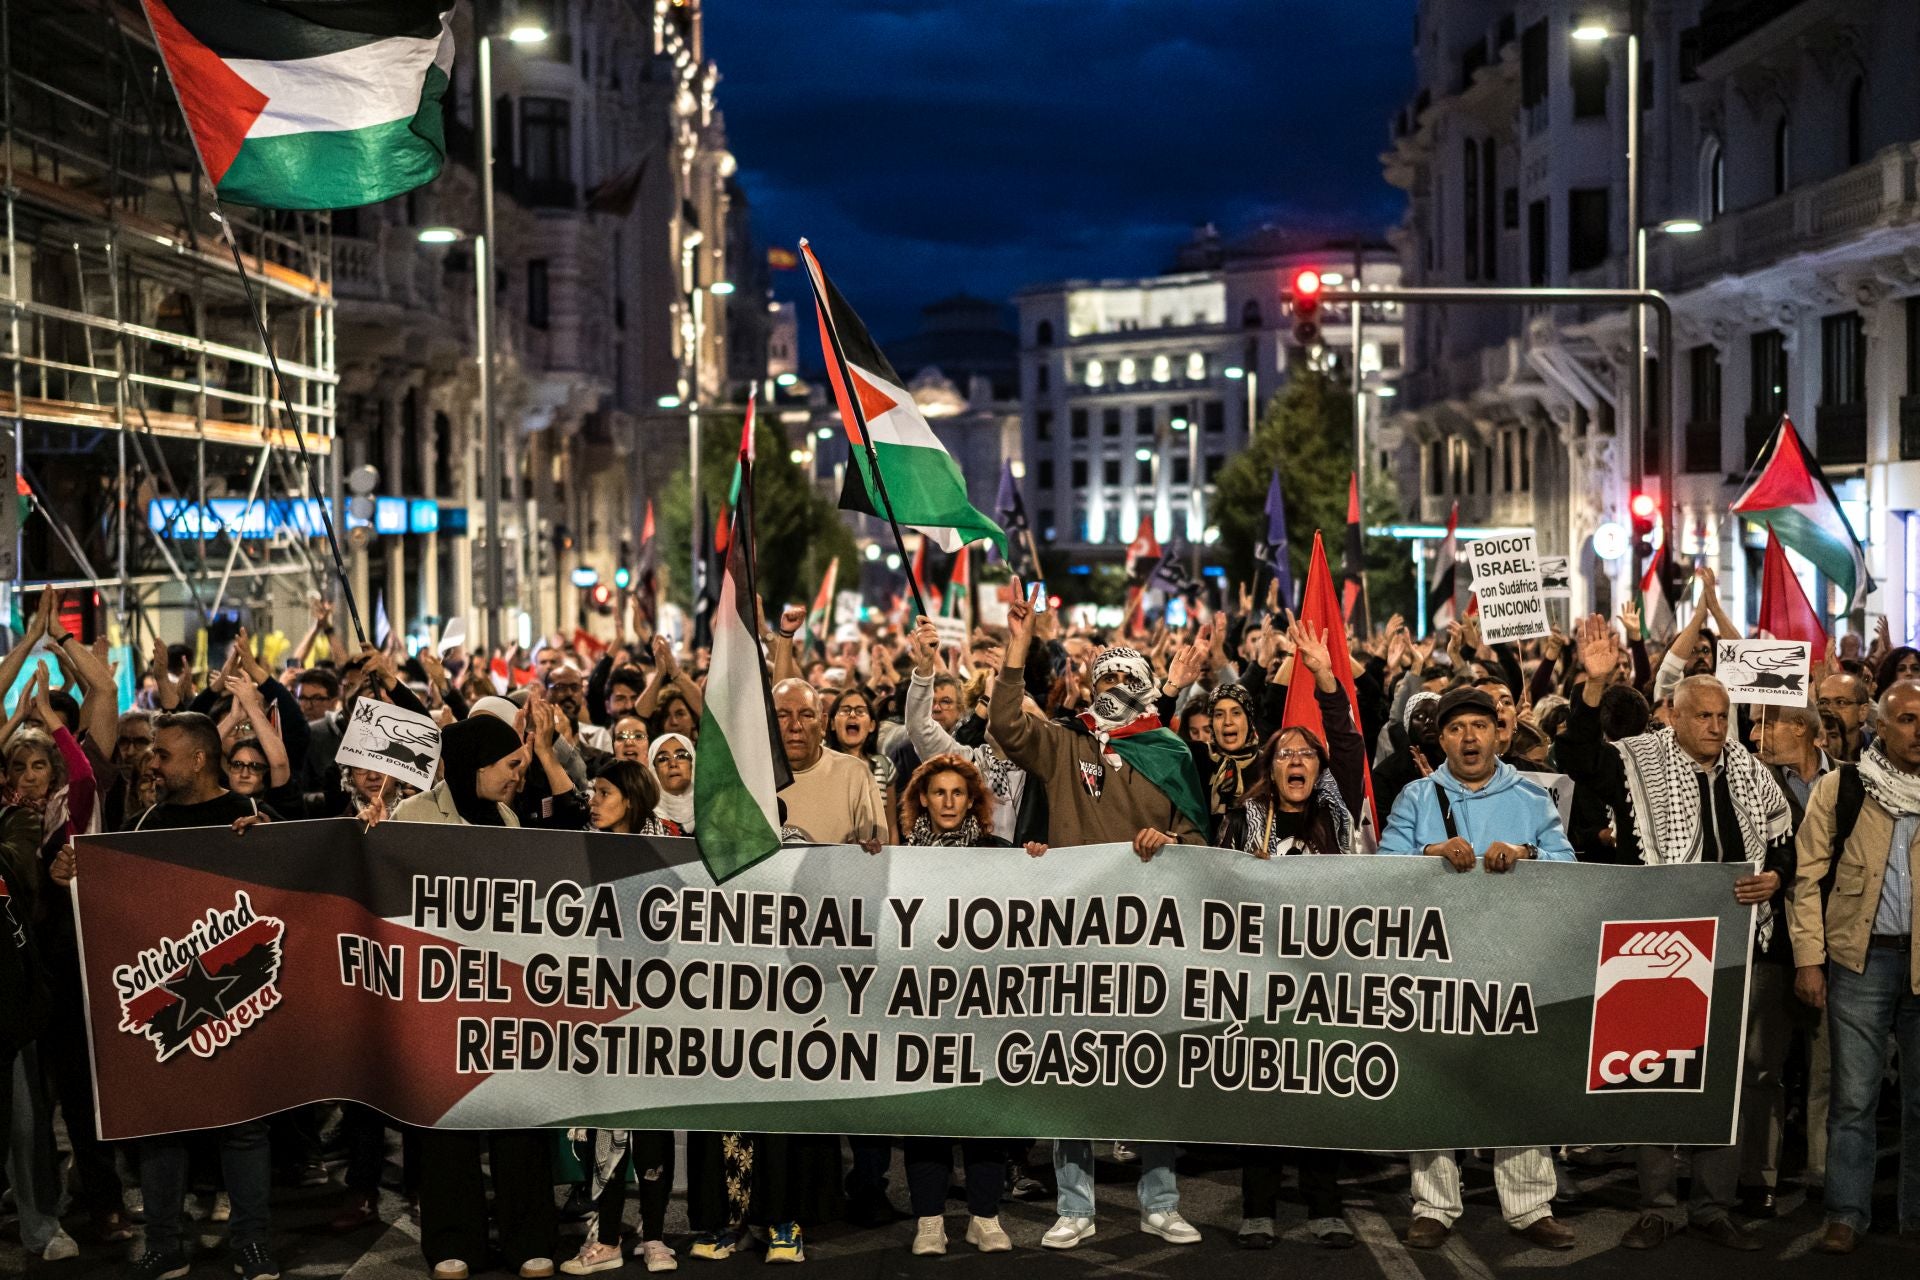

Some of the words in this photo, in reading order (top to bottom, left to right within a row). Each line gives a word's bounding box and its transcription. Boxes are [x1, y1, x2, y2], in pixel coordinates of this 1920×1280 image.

[1474, 537, 1531, 557] BOICOT
[1476, 558, 1535, 578] ISRAEL:
[1480, 587, 1497, 598] con
[1499, 579, 1538, 596] Sudáfrica
[1483, 595, 1541, 619] FUNCIONÓ!
[1486, 620, 1545, 640] www.boicotisrael.net
[1758, 688, 1804, 696] BOMBAS
[368, 752, 383, 761] NO
[386, 757, 430, 779] BOMBAS
[412, 875, 623, 941] HUELGA
[638, 885, 875, 950] GENERAL
[888, 896, 925, 951] Y
[935, 895, 1186, 952] JORNADA
[1201, 899, 1264, 957] DE
[1277, 904, 1452, 962] LUCHA
[115, 892, 256, 1001] Solidaridad
[337, 933, 404, 1001] FIN
[418, 945, 511, 1004] DEL
[522, 952, 825, 1016] GENOCIDIO
[838, 964, 878, 1018] Y
[886, 962, 1169, 1019] APARTHEID
[1182, 966, 1249, 1023] EN
[1264, 972, 1538, 1035] PALESTINA
[189, 984, 279, 1055] Obrera
[456, 1016, 879, 1083] REDISTIRBUCIÓN
[895, 1031, 983, 1086] DEL
[997, 1029, 1167, 1088] GASTO
[1178, 1020, 1399, 1100] PÚBLICO
[1598, 1050, 1696, 1084] CGT
